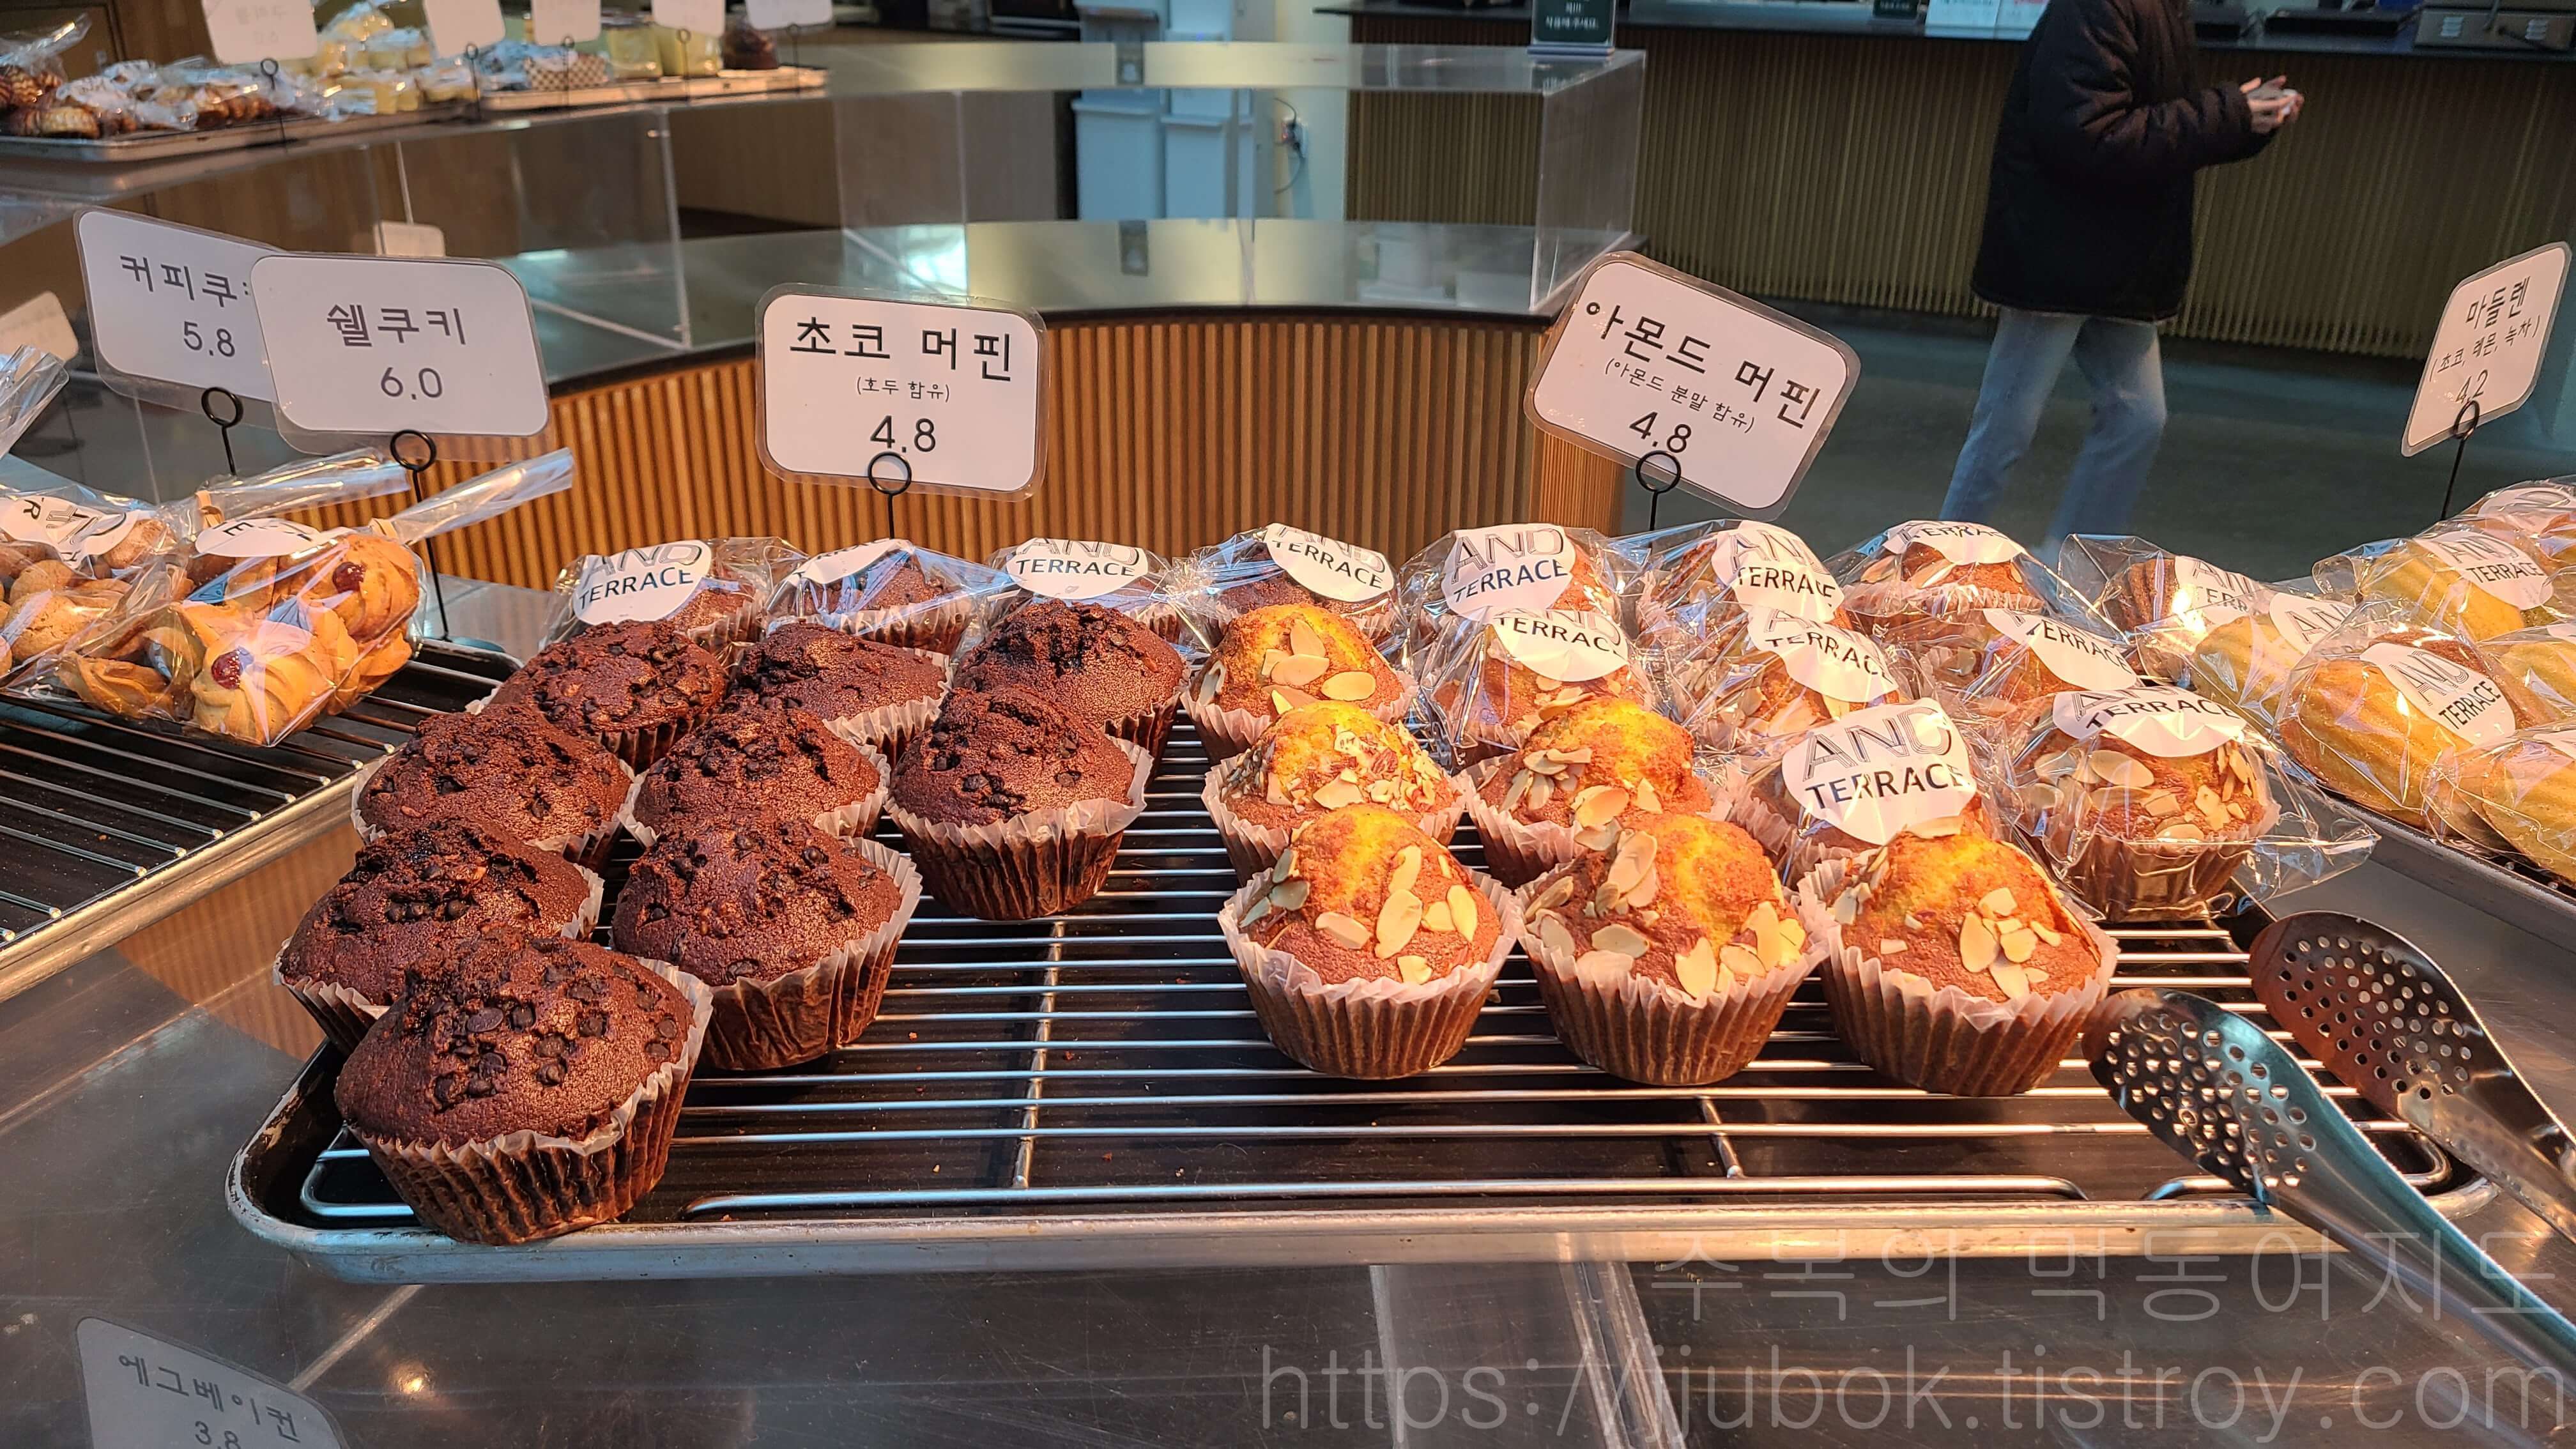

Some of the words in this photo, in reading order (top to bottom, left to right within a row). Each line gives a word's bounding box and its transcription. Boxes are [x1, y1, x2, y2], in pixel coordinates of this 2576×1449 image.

[120, 255, 250, 308] 커피쿠
[2465, 275, 2531, 330] 마들렌
[183, 321, 236, 358] 5.8
[326, 303, 466, 348] 쉘쿠키
[790, 316, 891, 359] 초코
[921, 328, 1011, 382] 머핀
[2429, 348, 2465, 382] (초코,
[2504, 314, 2540, 346] 녹차)
[380, 366, 443, 401] 6.0
[856, 376, 899, 395] (호두
[907, 381, 951, 402] 함유)
[1586, 302, 1711, 374] 아몬드
[1734, 360, 1821, 429] 머핀
[1604, 356, 1664, 392] (아몬드
[1670, 385, 1708, 412] 분말
[1713, 402, 1757, 434] 함유)
[869, 415, 937, 453] 4.8
[1629, 411, 1692, 454] 4.8
[1015, 558, 1135, 576] TERRACE
[1272, 540, 1384, 590] TERRACE
[1450, 528, 1565, 584] AND
[2465, 562, 2545, 583] TERRACE
[578, 567, 694, 610] TERRACE
[1453, 558, 1569, 603] TERRACE
[1493, 617, 1626, 659] TERRAC
[1765, 631, 1894, 685] TERRAC
[2389, 649, 2470, 707] AND
[2085, 698, 2241, 729] TERRACE
[2438, 680, 2503, 730] TERRACE
[1802, 706, 1952, 782] AND
[1804, 763, 1971, 809] TERRACE
[118, 1354, 301, 1443] 에그베이컨
